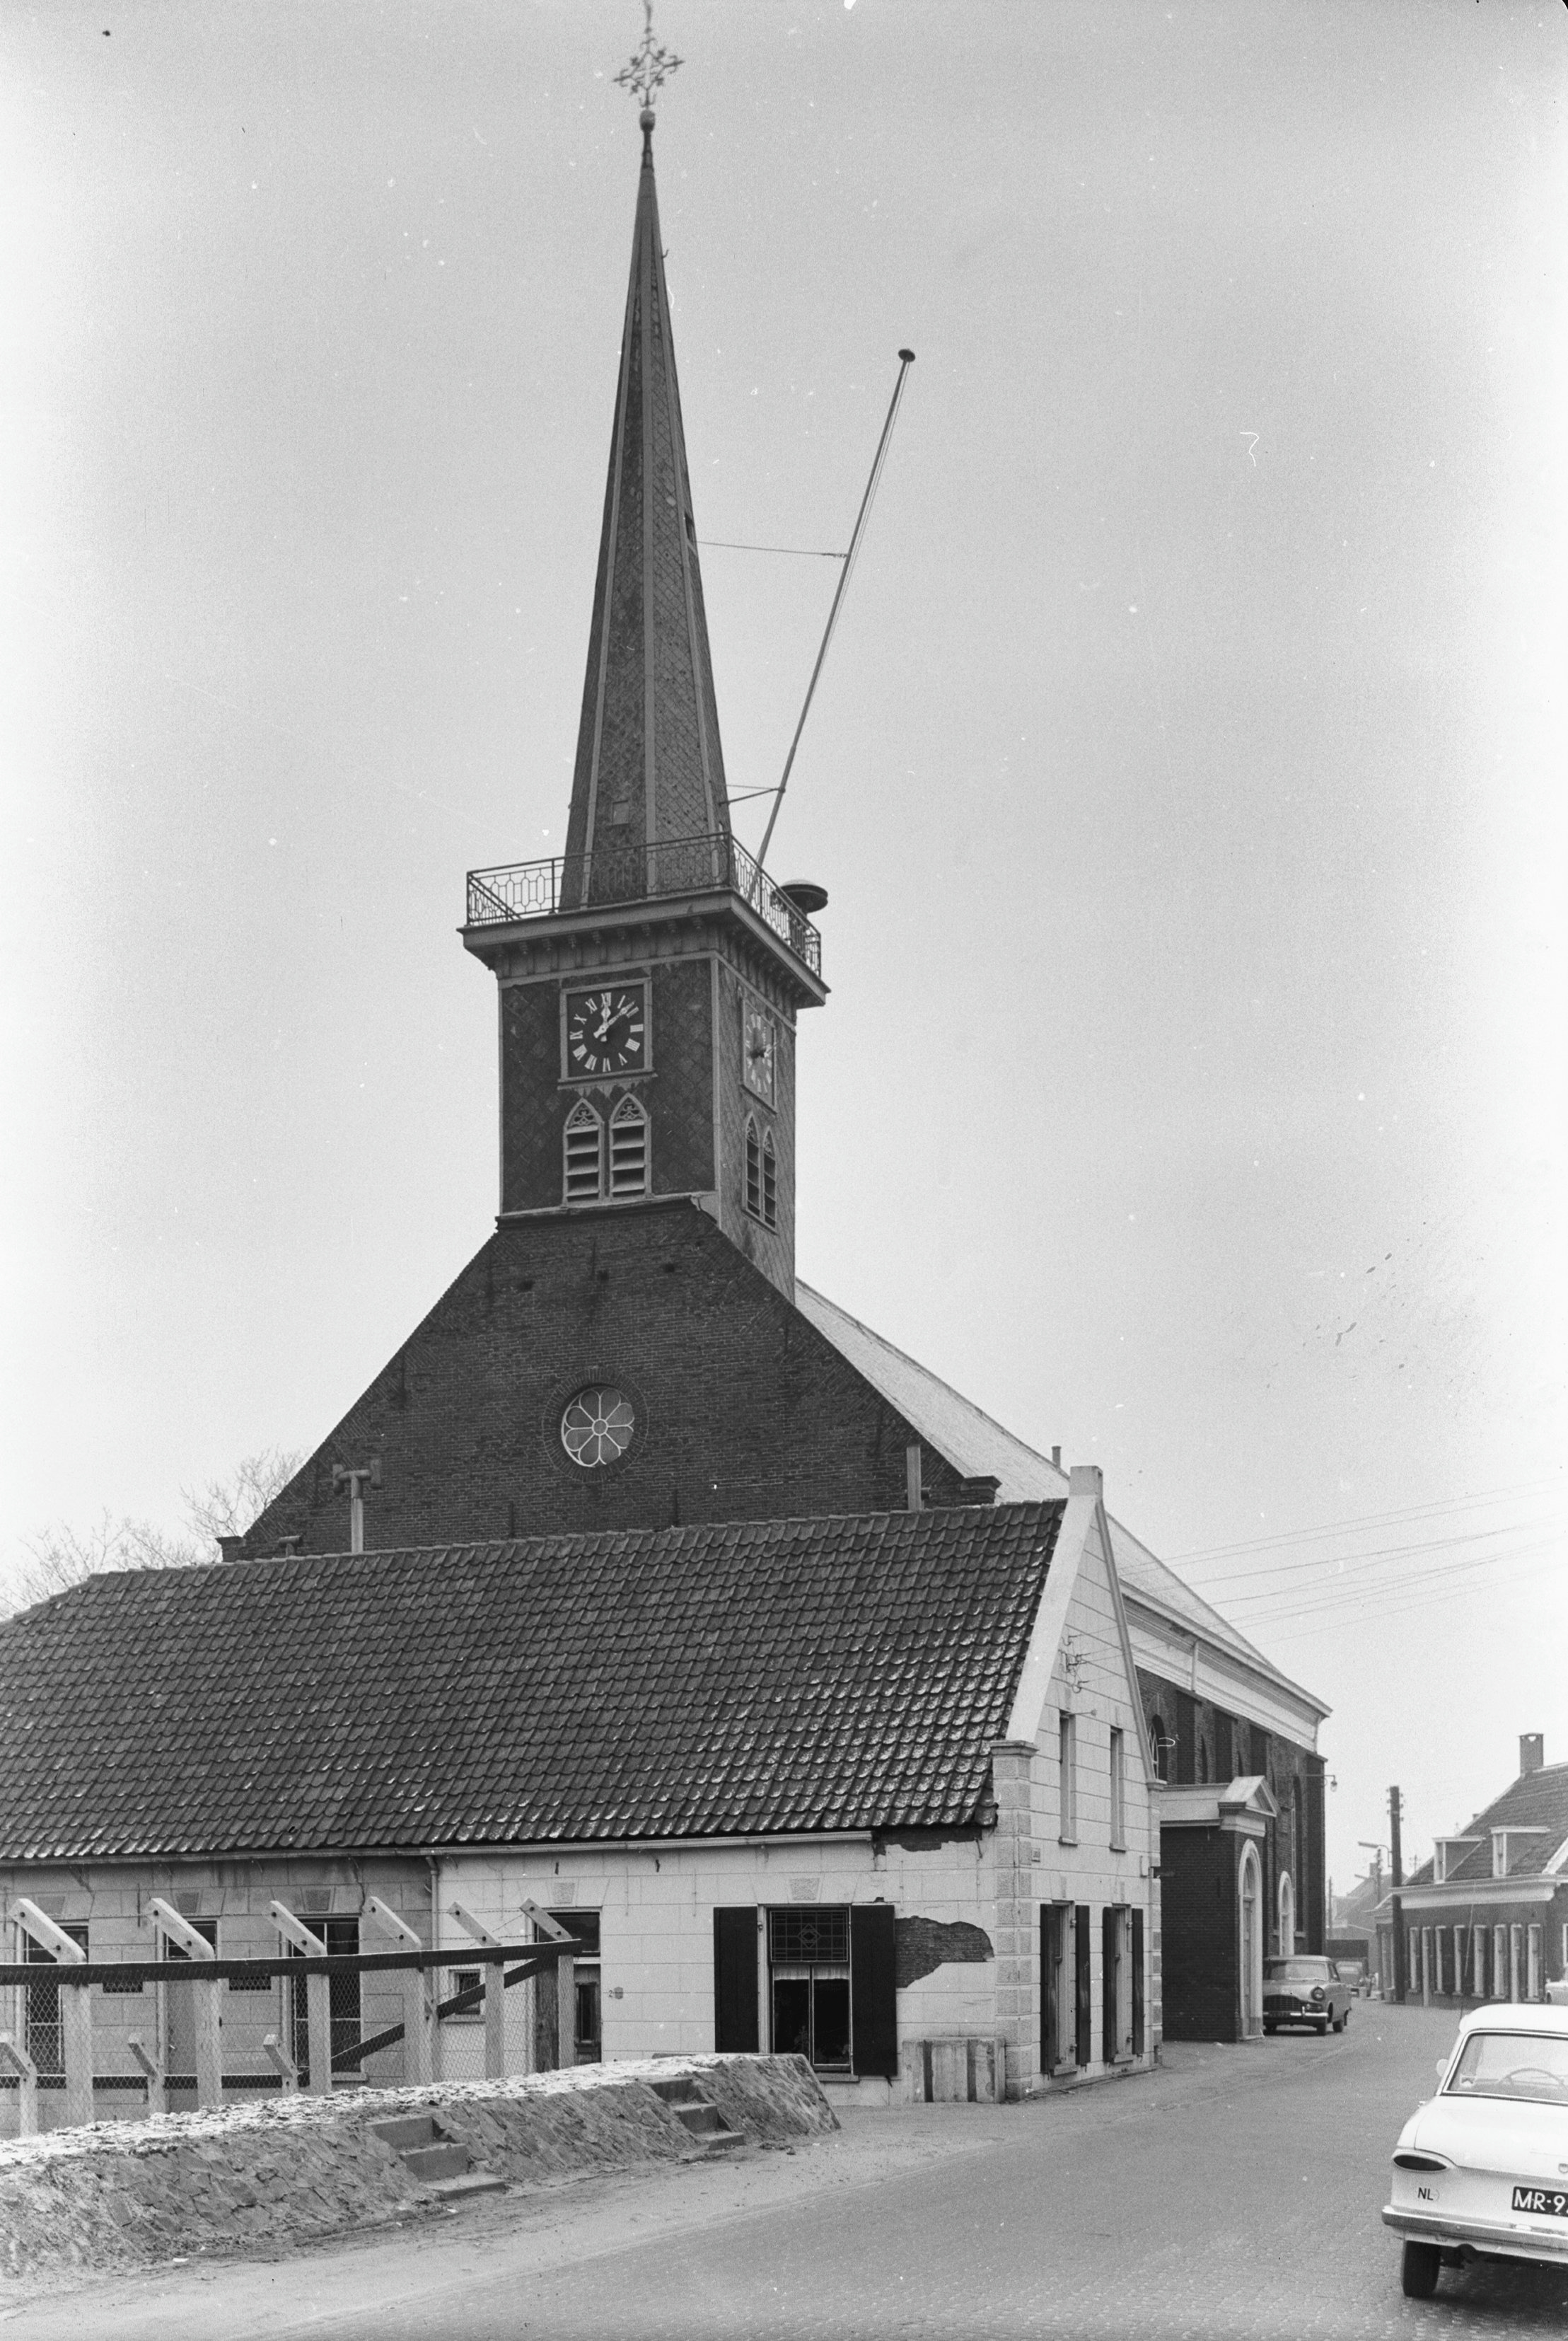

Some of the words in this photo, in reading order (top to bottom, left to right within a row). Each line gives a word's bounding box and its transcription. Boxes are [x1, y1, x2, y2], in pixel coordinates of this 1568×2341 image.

[574, 1013, 587, 1025] X
[618, 1052, 628, 1066] V
[1417, 2187, 1434, 2201] NL
[1514, 2188, 1568, 2214] MR-9
